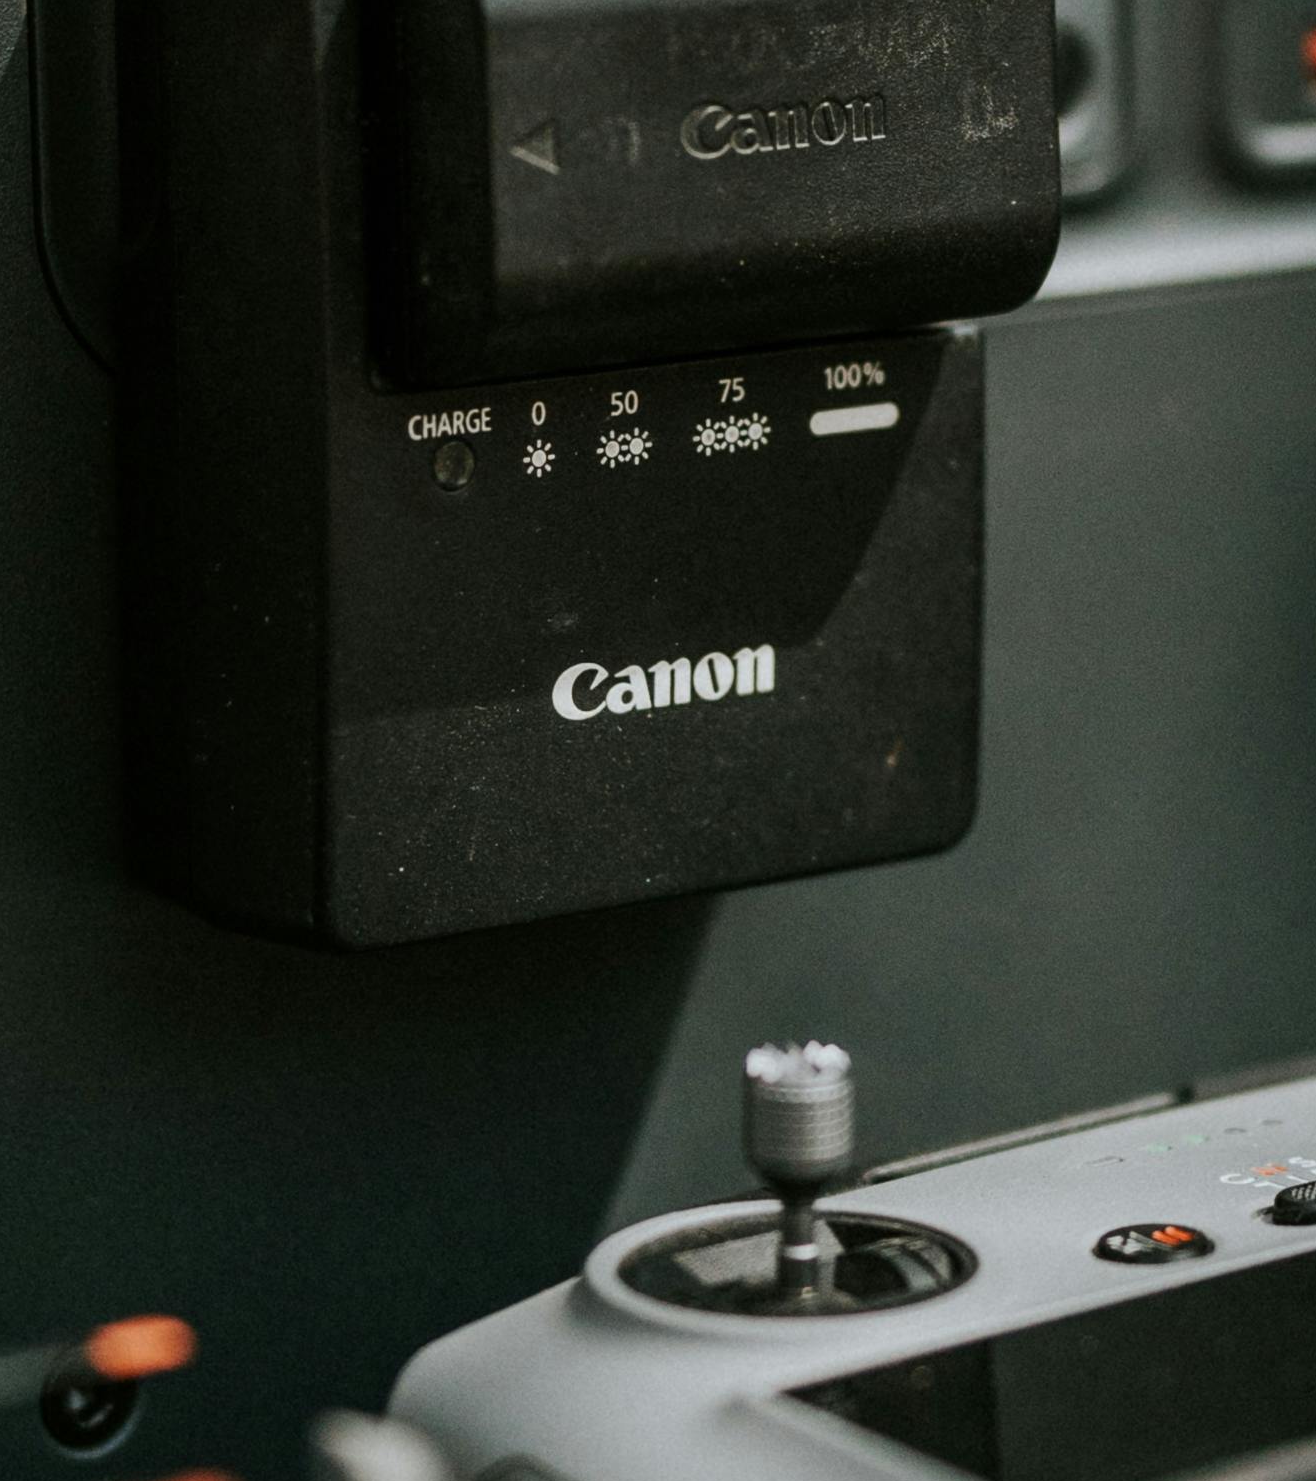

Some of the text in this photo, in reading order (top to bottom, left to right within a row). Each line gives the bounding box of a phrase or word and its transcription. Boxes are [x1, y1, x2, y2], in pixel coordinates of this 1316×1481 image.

[680, 95, 886, 160] Canon
[407, 406, 493, 441] CHARGE
[609, 390, 639, 417] 50
[718, 377, 746, 403] 75
[824, 362, 885, 390] 100%
[551, 643, 776, 721] Canon
